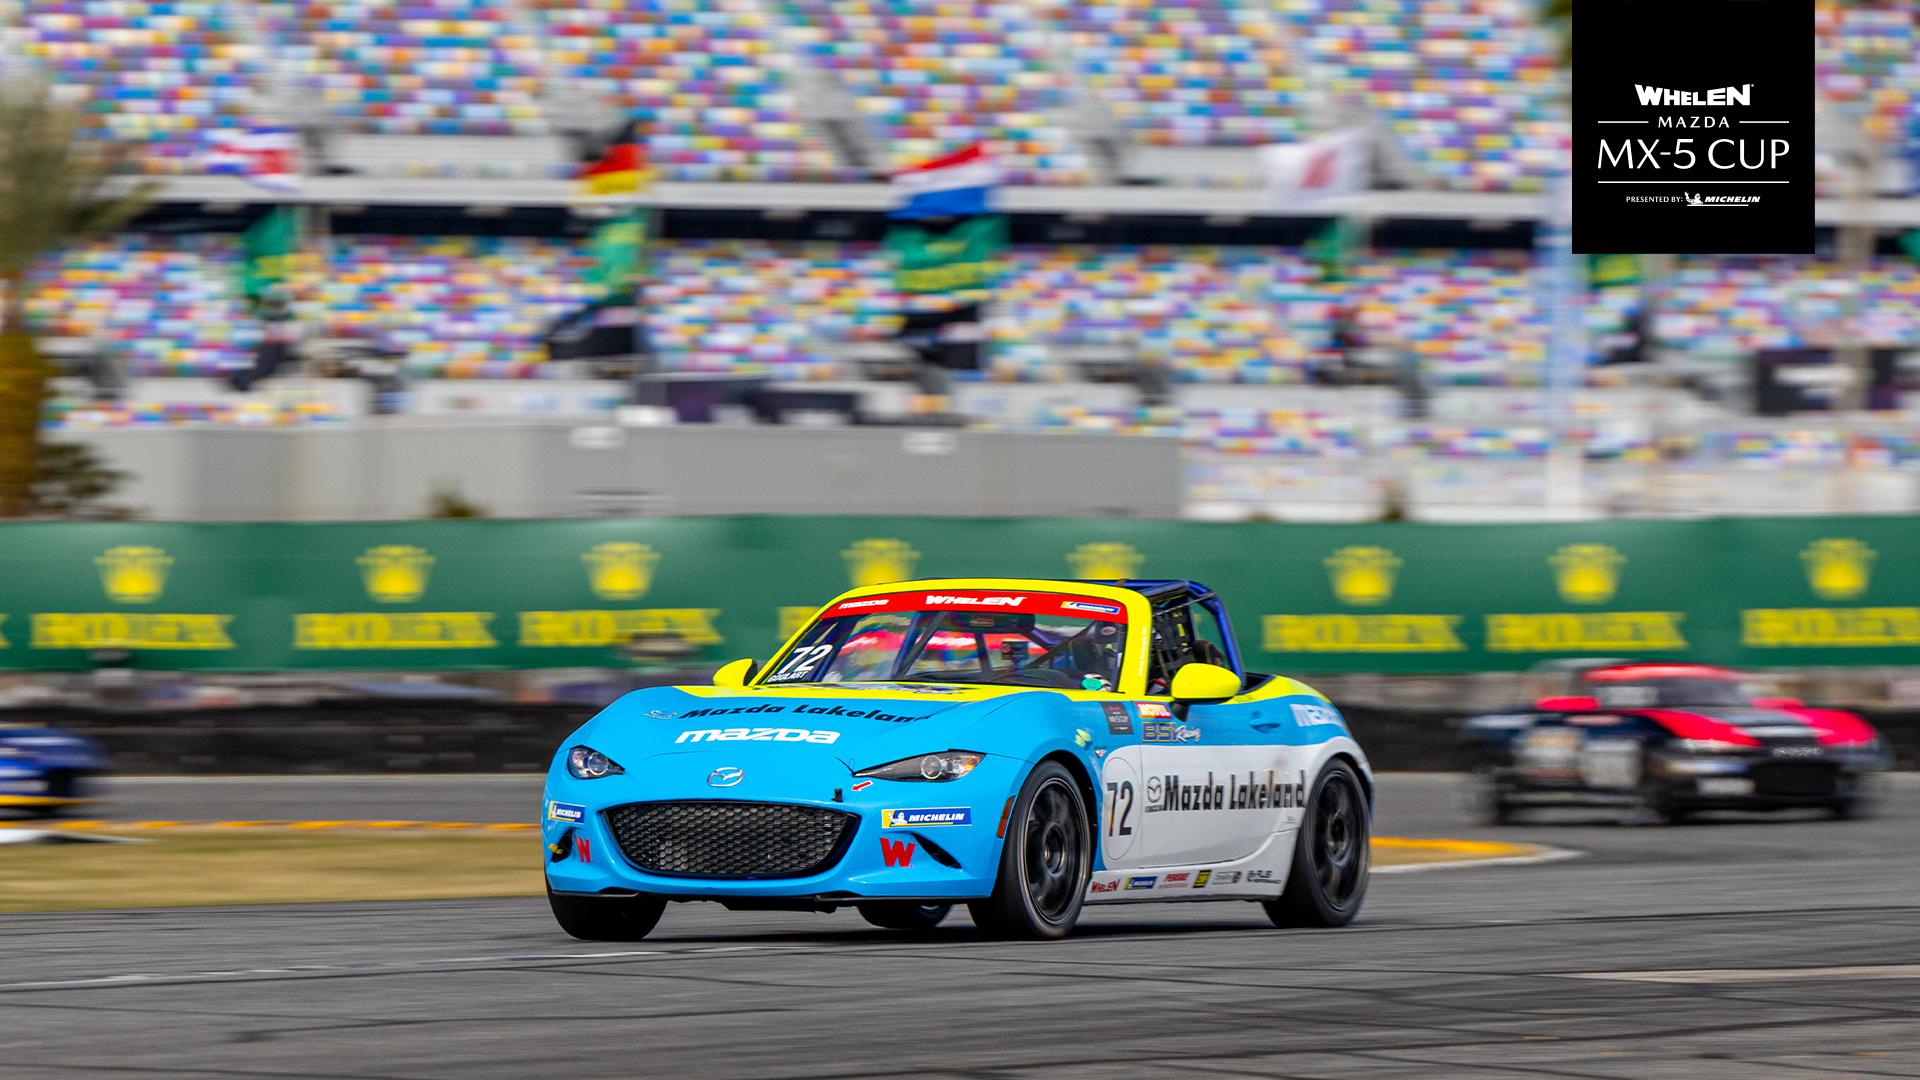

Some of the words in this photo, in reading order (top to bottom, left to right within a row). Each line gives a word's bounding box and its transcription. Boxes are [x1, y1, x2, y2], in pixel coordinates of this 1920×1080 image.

[925, 595, 1026, 606] WHELEN
[776, 644, 833, 675] 72
[678, 704, 786, 719] Mazda
[1163, 771, 1225, 811] Mazda
[1229, 770, 1307, 810] Lakeland
[908, 812, 965, 822] MICHELIN
[1106, 780, 1134, 837] 72
[573, 834, 592, 863] W
[879, 837, 917, 868] W
